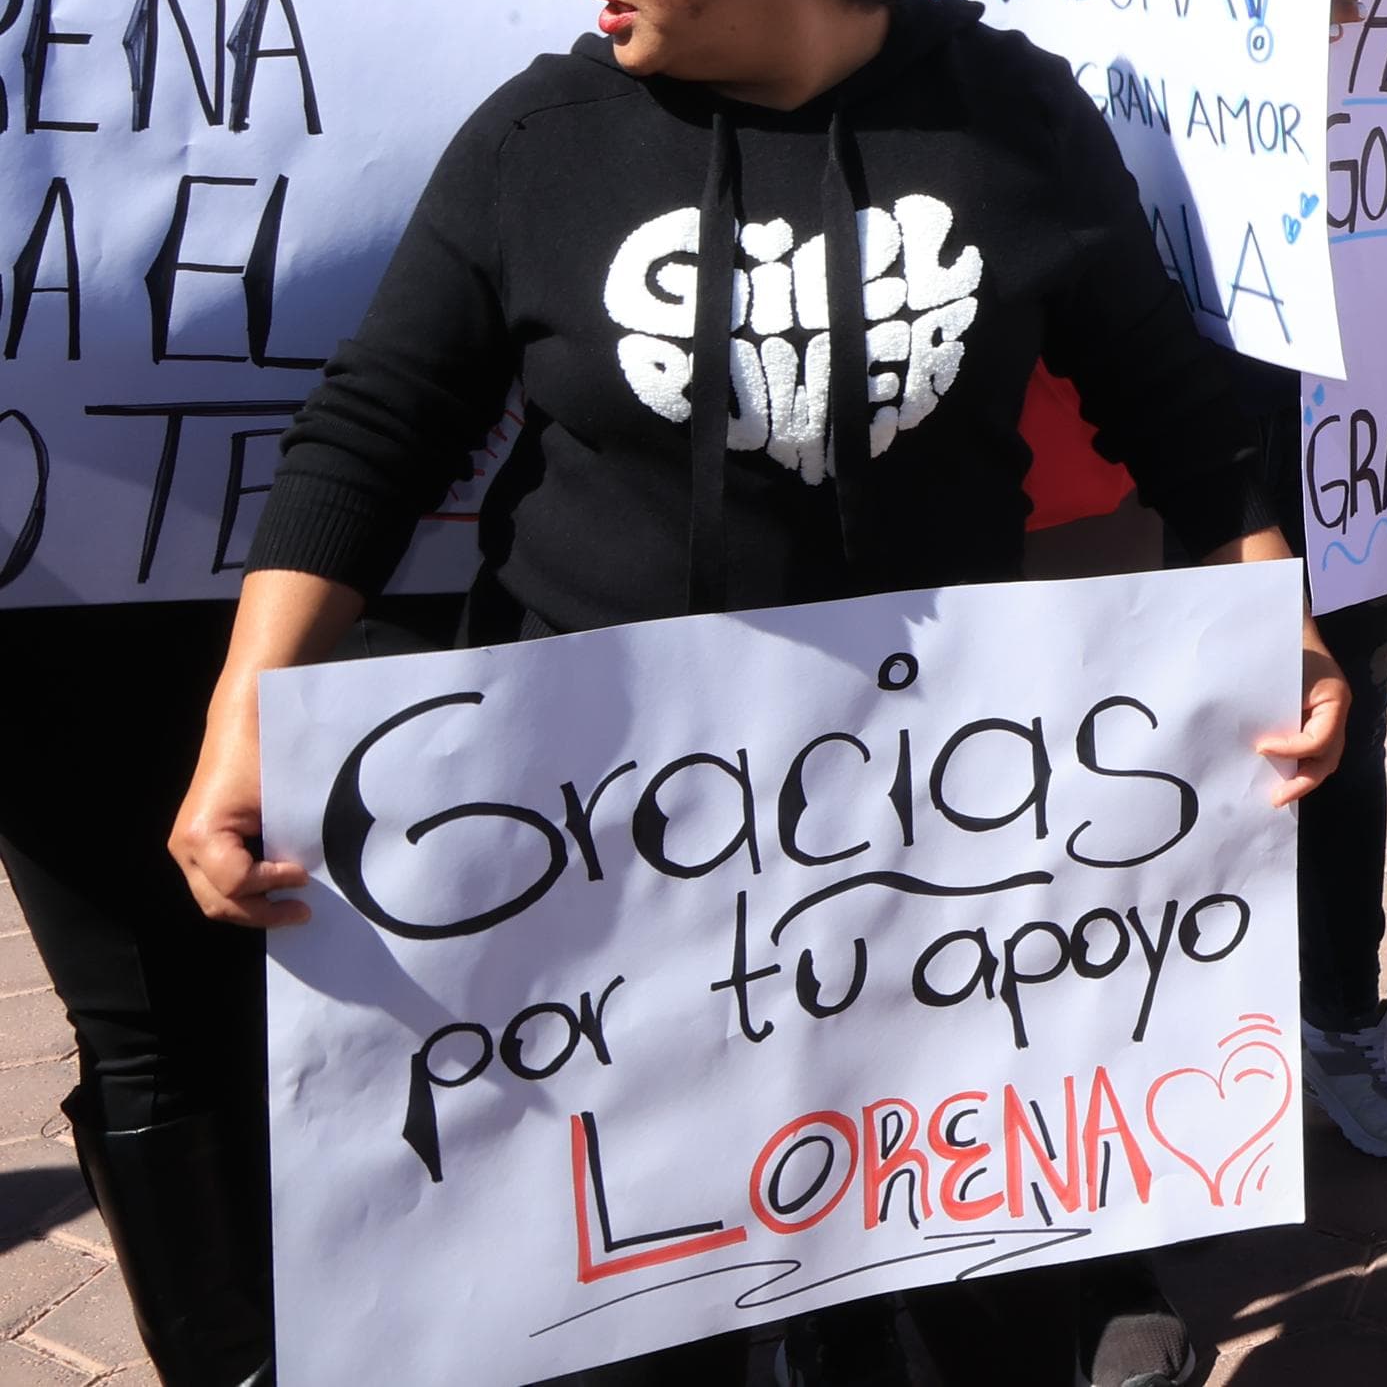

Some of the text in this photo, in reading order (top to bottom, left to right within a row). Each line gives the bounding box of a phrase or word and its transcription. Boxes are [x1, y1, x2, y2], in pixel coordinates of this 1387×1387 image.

[1186, 88, 1309, 165] AMOR
[321, 650, 1200, 940] Gracias
[911, 893, 1250, 1049] apoyo
[402, 973, 625, 1183] por
[570, 1064, 1152, 1284] LORENA
